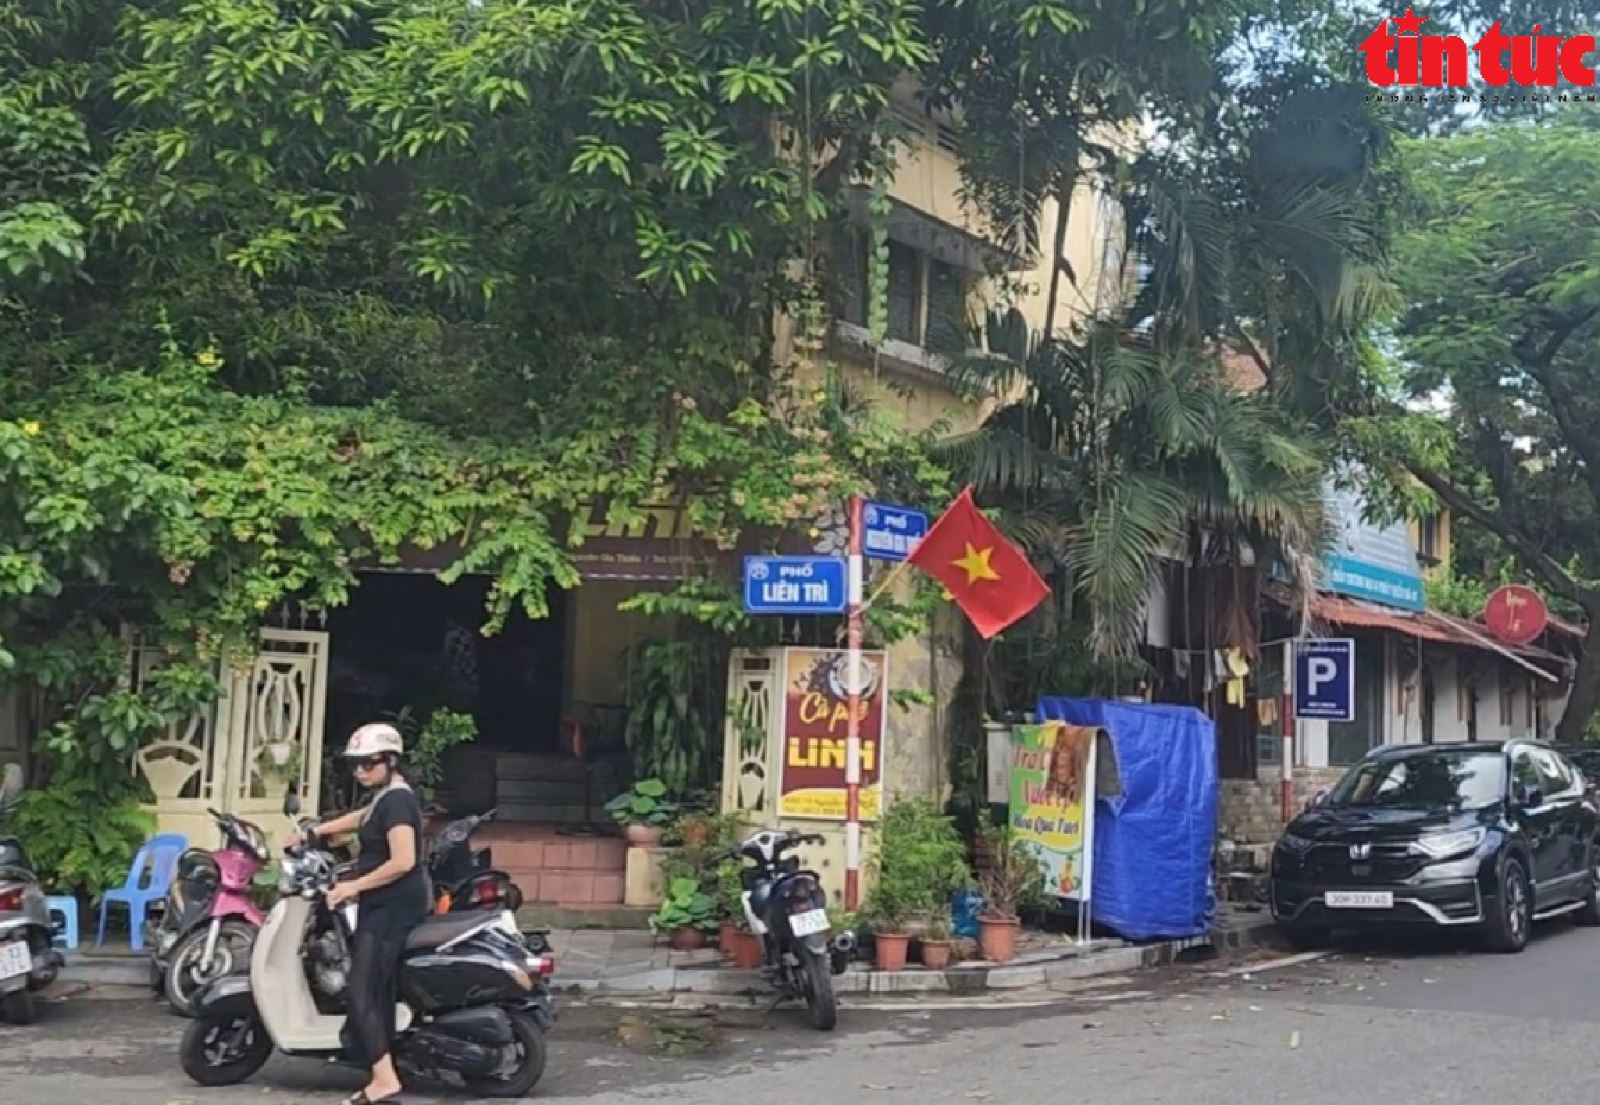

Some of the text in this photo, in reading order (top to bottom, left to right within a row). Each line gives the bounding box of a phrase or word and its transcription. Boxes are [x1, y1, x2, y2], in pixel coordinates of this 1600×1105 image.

[780, 563, 813, 577] PHỐ
[763, 580, 828, 602] LIÊN TRÌ
[1308, 657, 1337, 696] P
[788, 736, 875, 771] LINH
